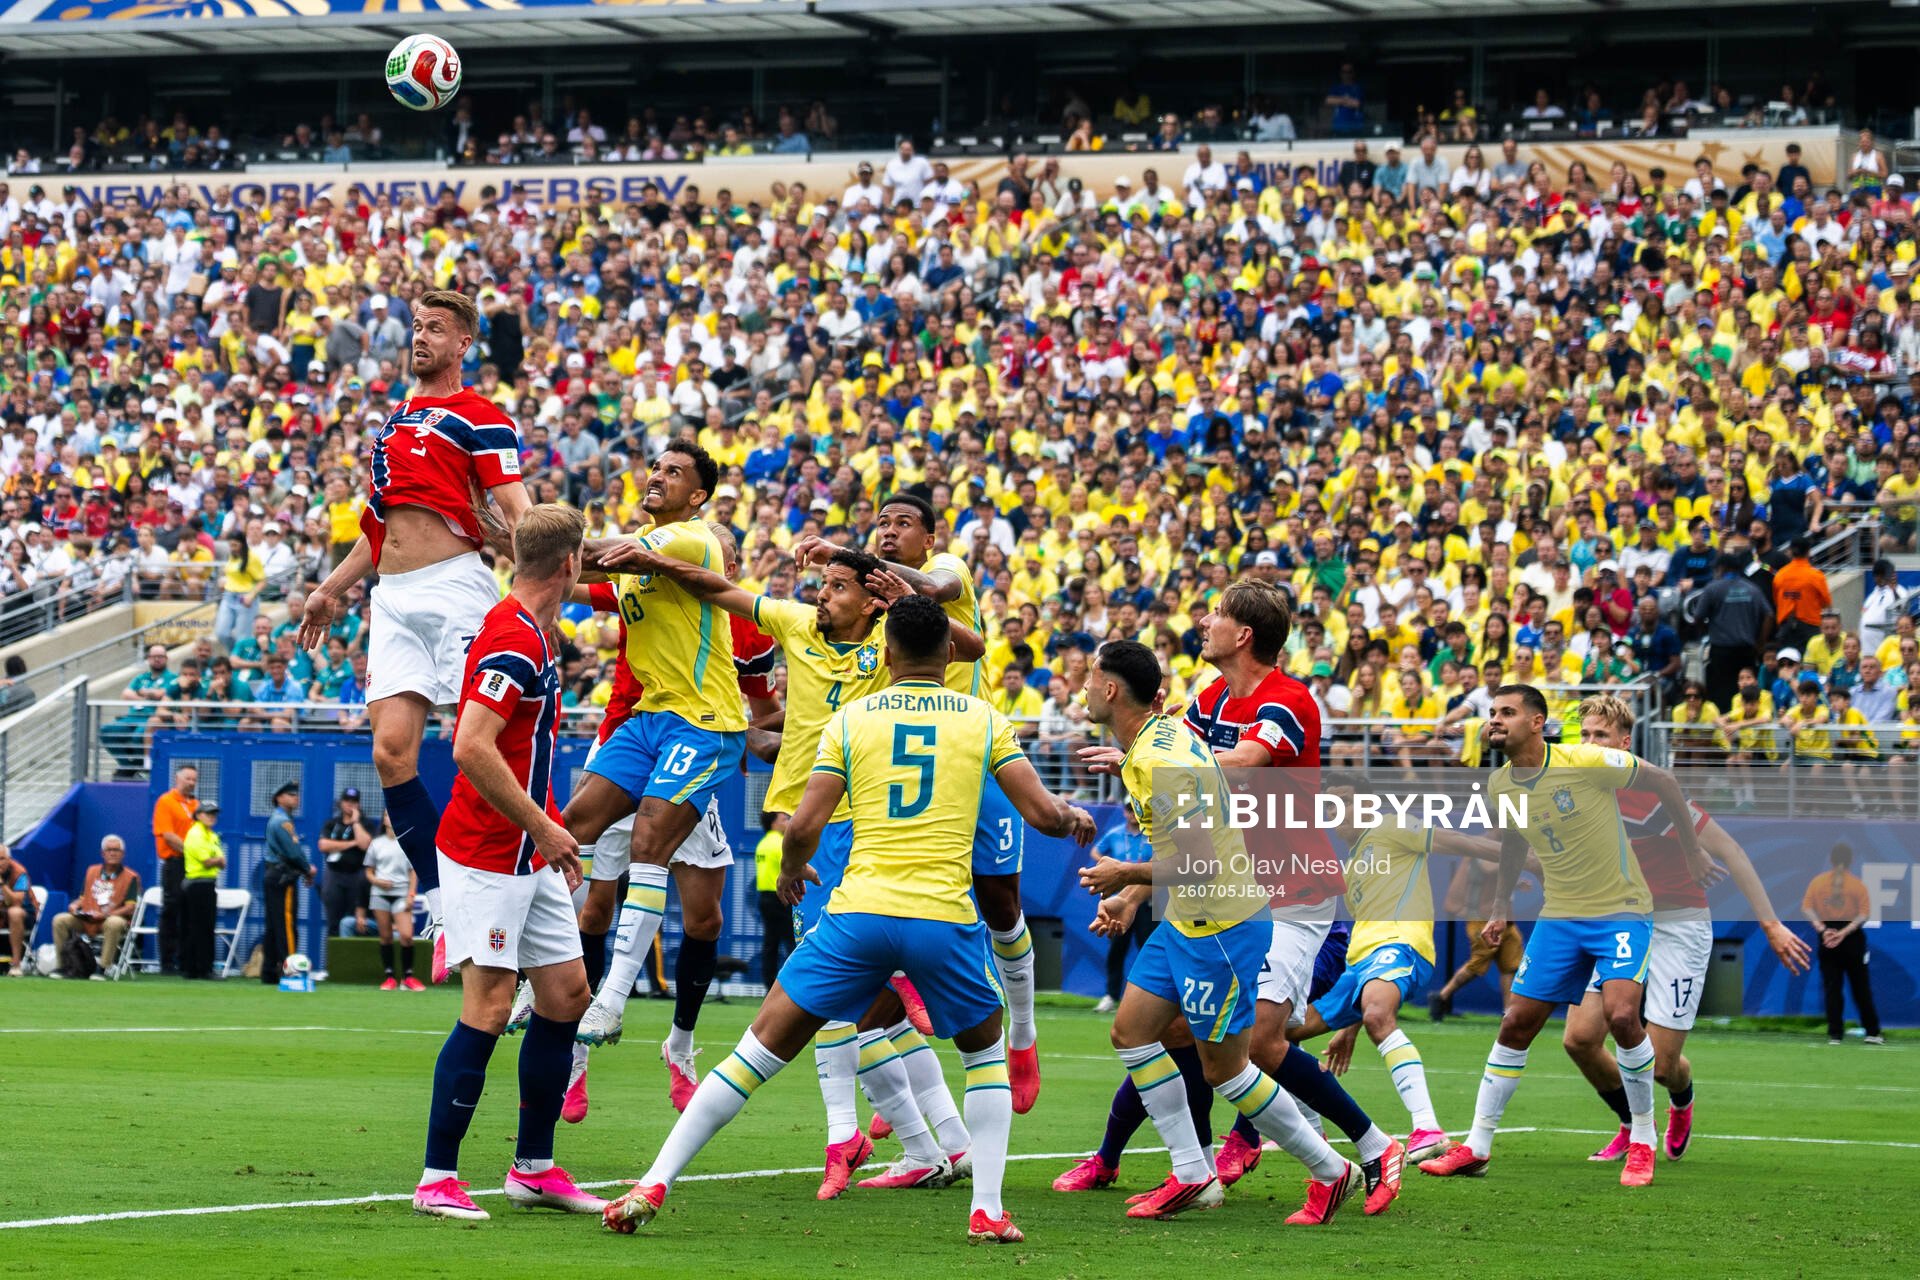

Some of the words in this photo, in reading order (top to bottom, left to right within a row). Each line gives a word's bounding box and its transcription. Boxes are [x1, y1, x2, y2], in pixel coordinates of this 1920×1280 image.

[1269, 160, 1339, 187] Wld
[76, 185, 166, 210] NEW
[353, 181, 465, 207] NEW
[496, 176, 687, 204] JERSEY
[621, 593, 645, 625] 13
[461, 635, 476, 655] 7
[826, 680, 842, 712] 4
[866, 694, 969, 713] CASEMIRO
[663, 743, 698, 776] 13
[889, 723, 937, 819] 5
[999, 818, 1013, 851] 3
[1541, 827, 1565, 853] 8
[1615, 931, 1632, 959] 8
[1182, 977, 1216, 1016] 22
[1671, 978, 1693, 1007] 17
